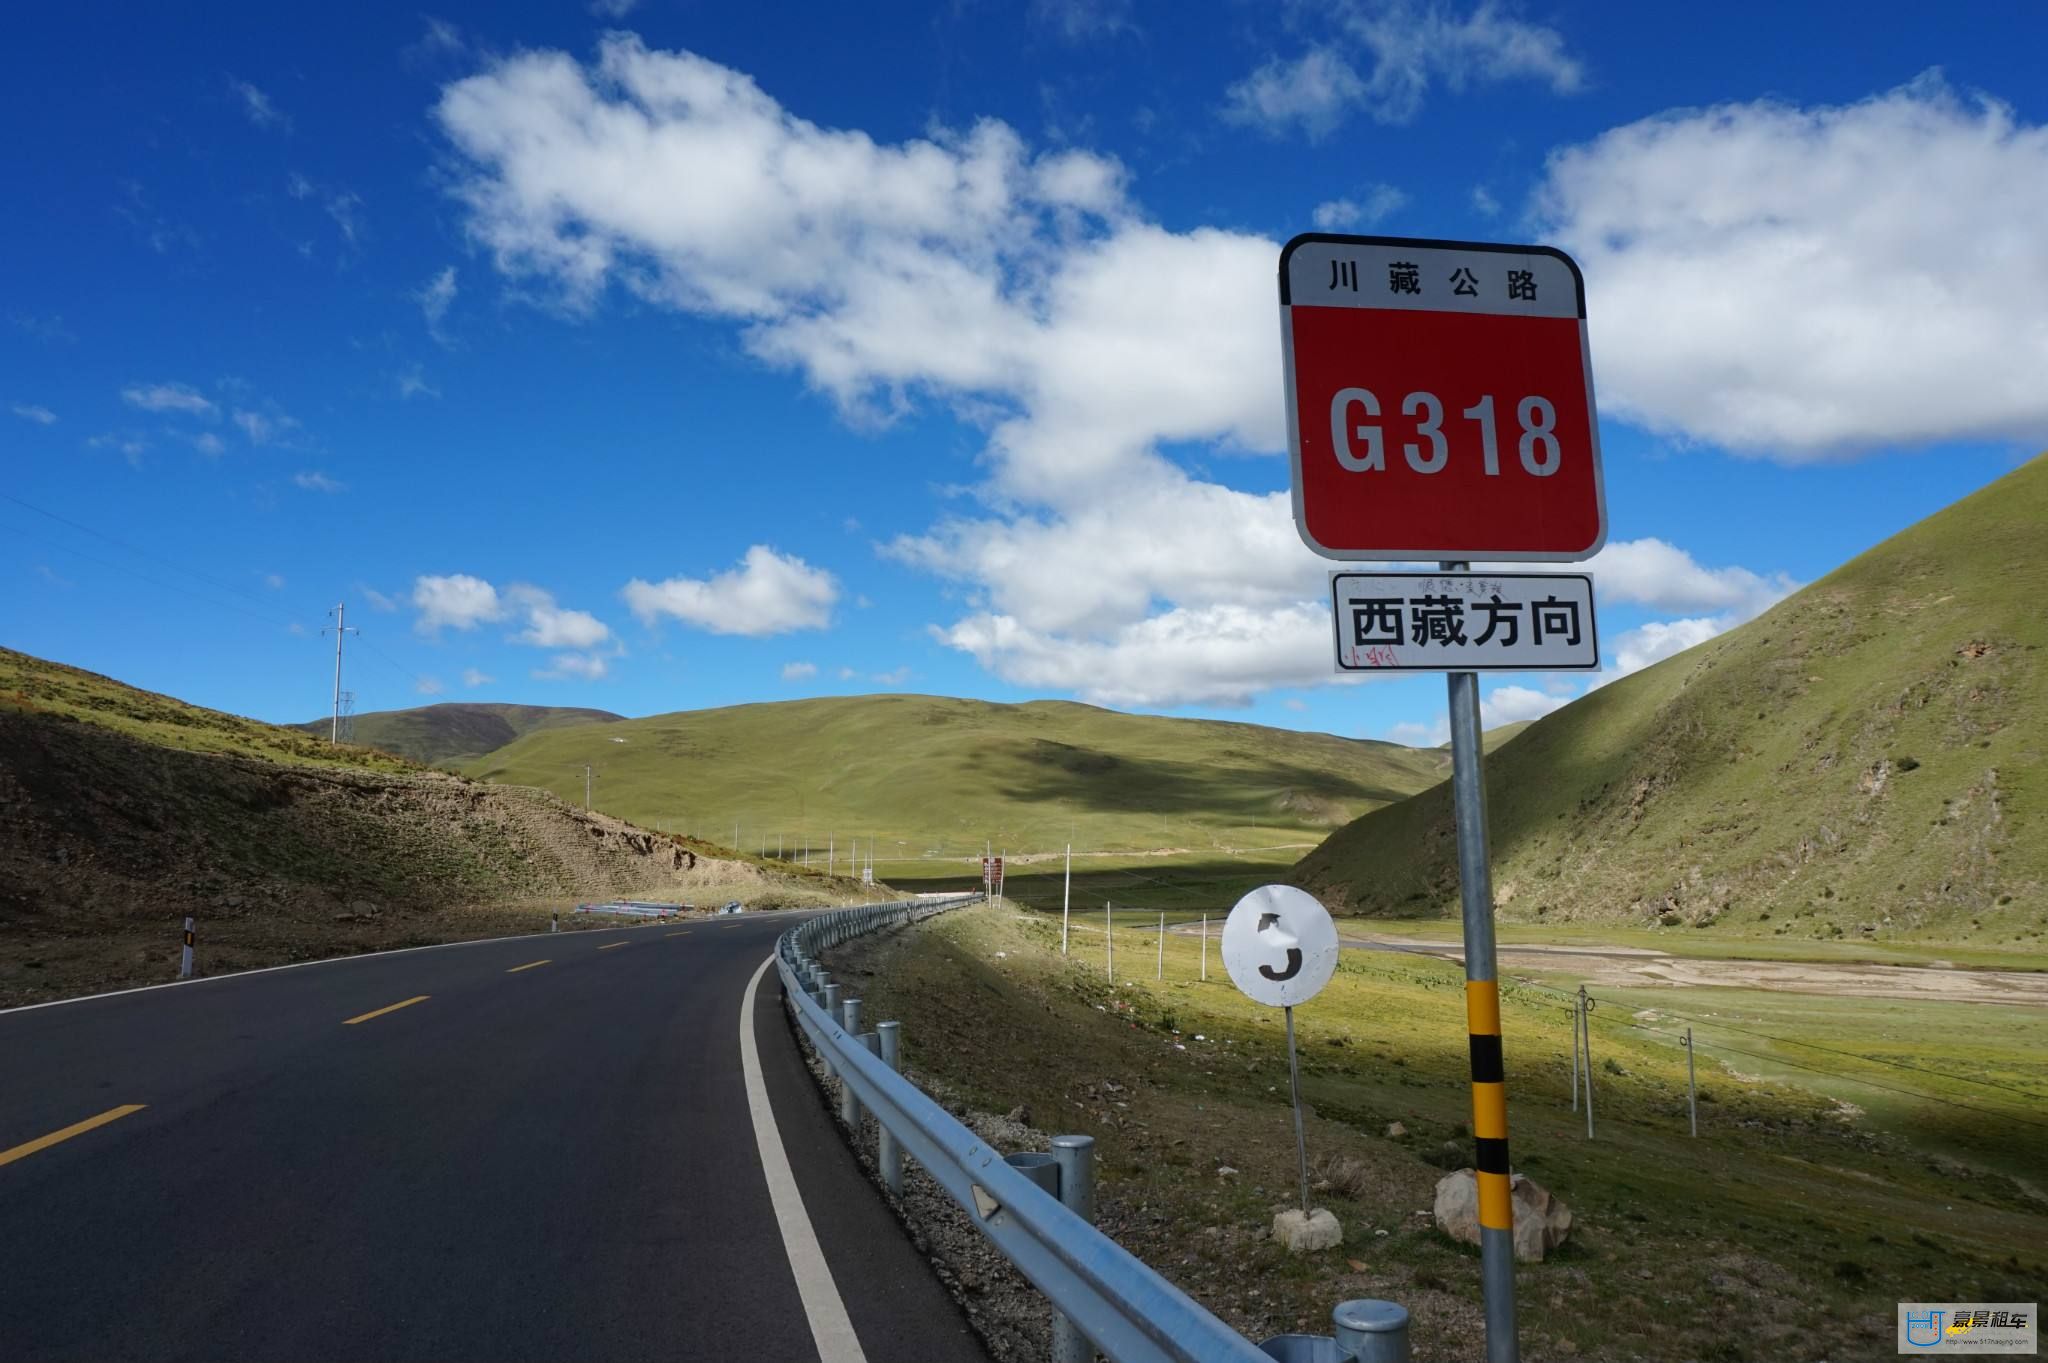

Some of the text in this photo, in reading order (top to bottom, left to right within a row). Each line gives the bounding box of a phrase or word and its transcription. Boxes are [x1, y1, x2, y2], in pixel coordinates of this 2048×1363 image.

[1329, 260, 1537, 300] 川藏公路
[1330, 387, 1561, 477] G318
[1349, 594, 1582, 647] 西藏方向
